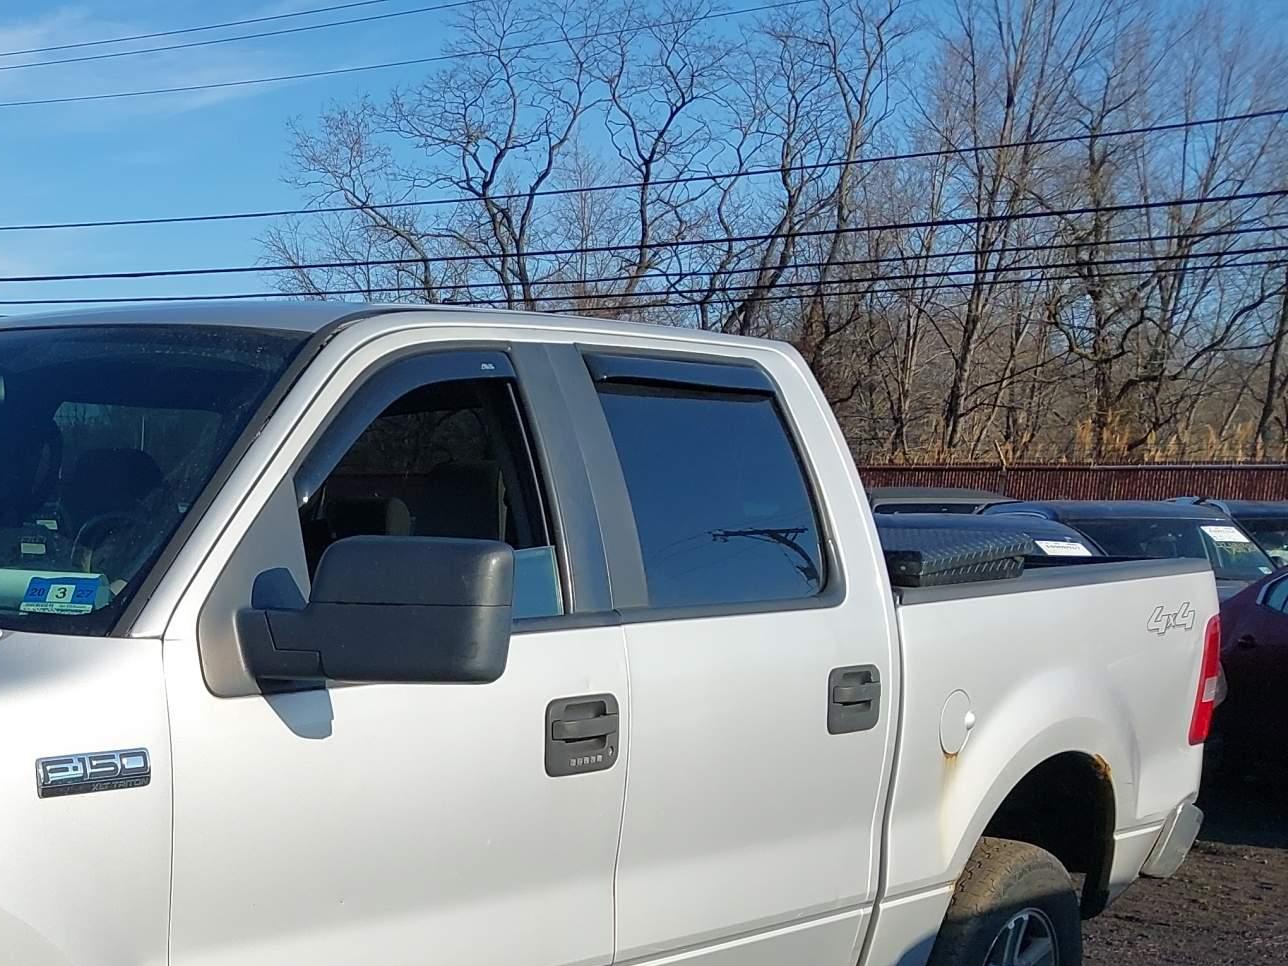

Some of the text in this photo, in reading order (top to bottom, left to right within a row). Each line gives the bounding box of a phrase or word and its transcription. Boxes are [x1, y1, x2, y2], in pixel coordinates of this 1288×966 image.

[29, 587, 45, 597] 20
[55, 587, 67, 599] 3
[1146, 600, 1195, 635] 4x4
